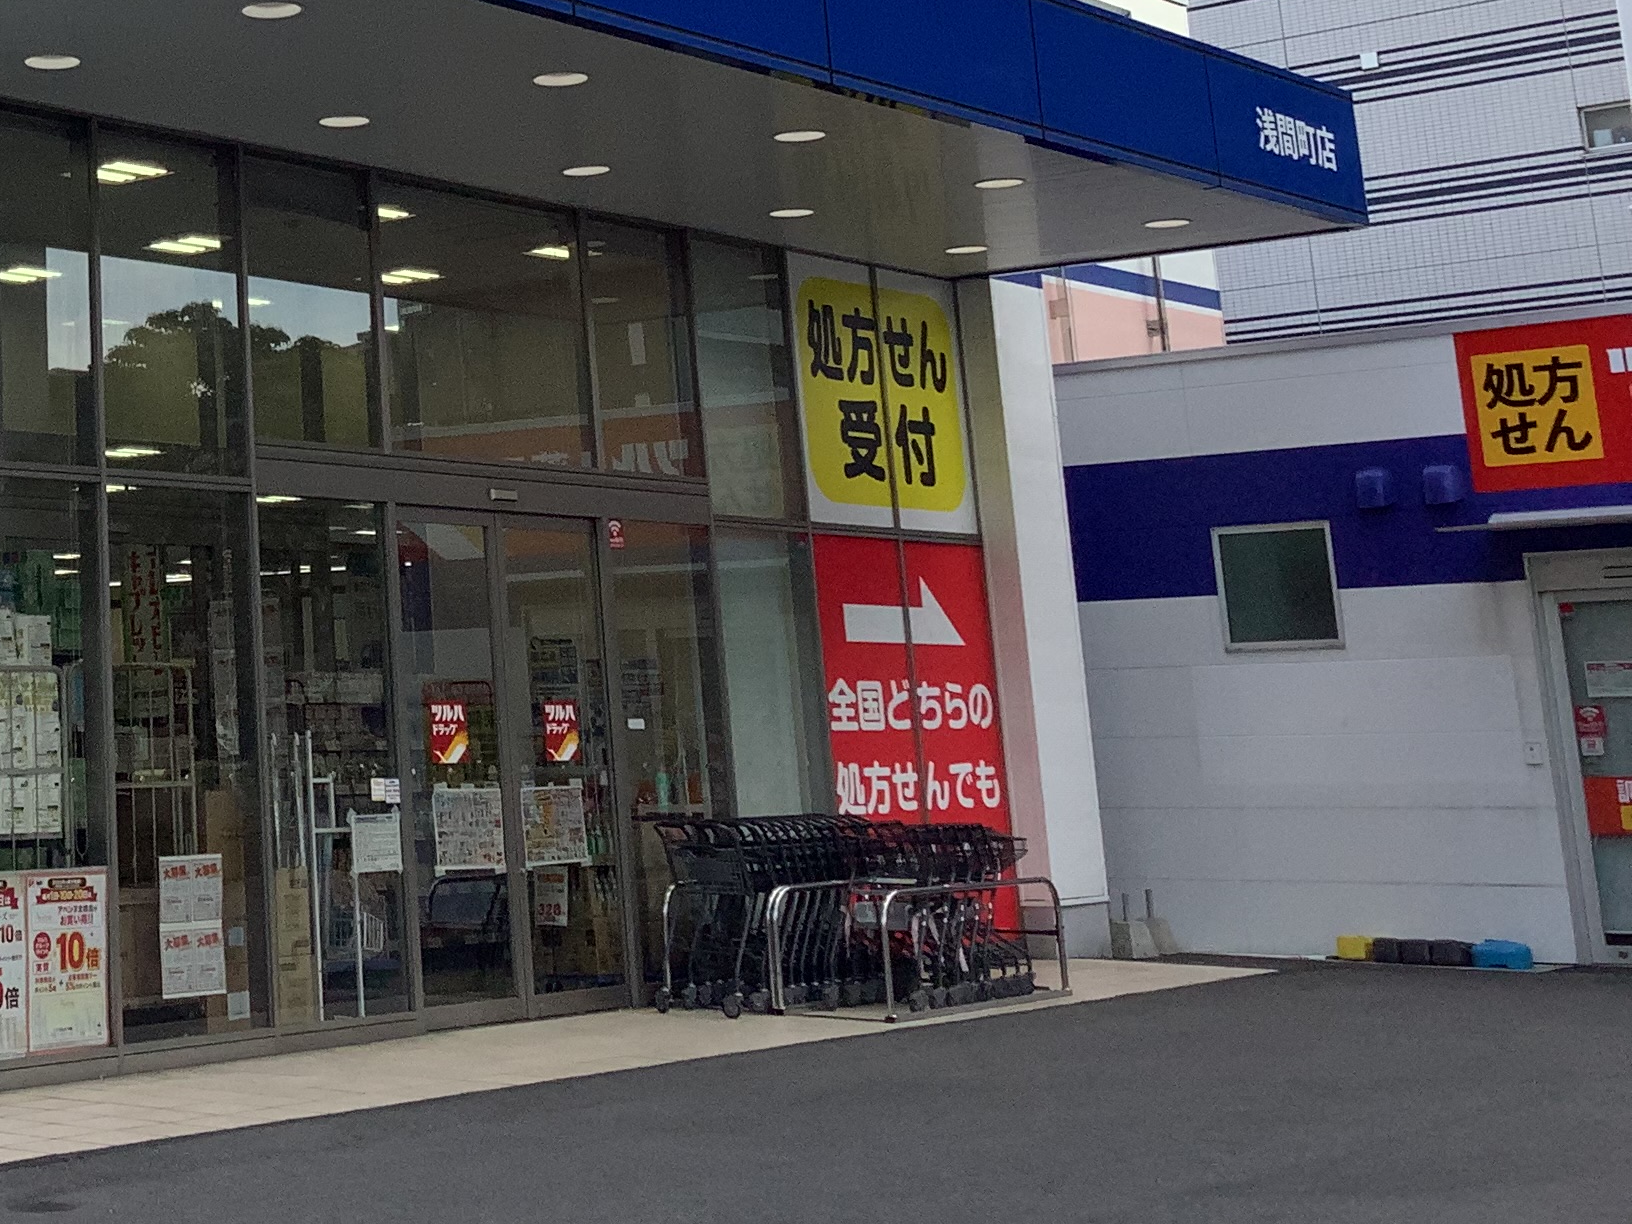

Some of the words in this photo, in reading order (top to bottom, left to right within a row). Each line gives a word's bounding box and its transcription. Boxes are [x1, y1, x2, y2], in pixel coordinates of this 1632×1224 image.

[1256, 106, 1337, 172] 浅間町店
[807, 299, 947, 393] 処方せん
[1483, 356, 1582, 409] 処方
[838, 399, 936, 487] 受付
[1490, 408, 1593, 455] せん
[431, 704, 465, 721] ツルハ
[544, 704, 576, 721] ツルハ
[828, 678, 993, 731] 全国どちらの
[836, 759, 1000, 815] 処方せんでも
